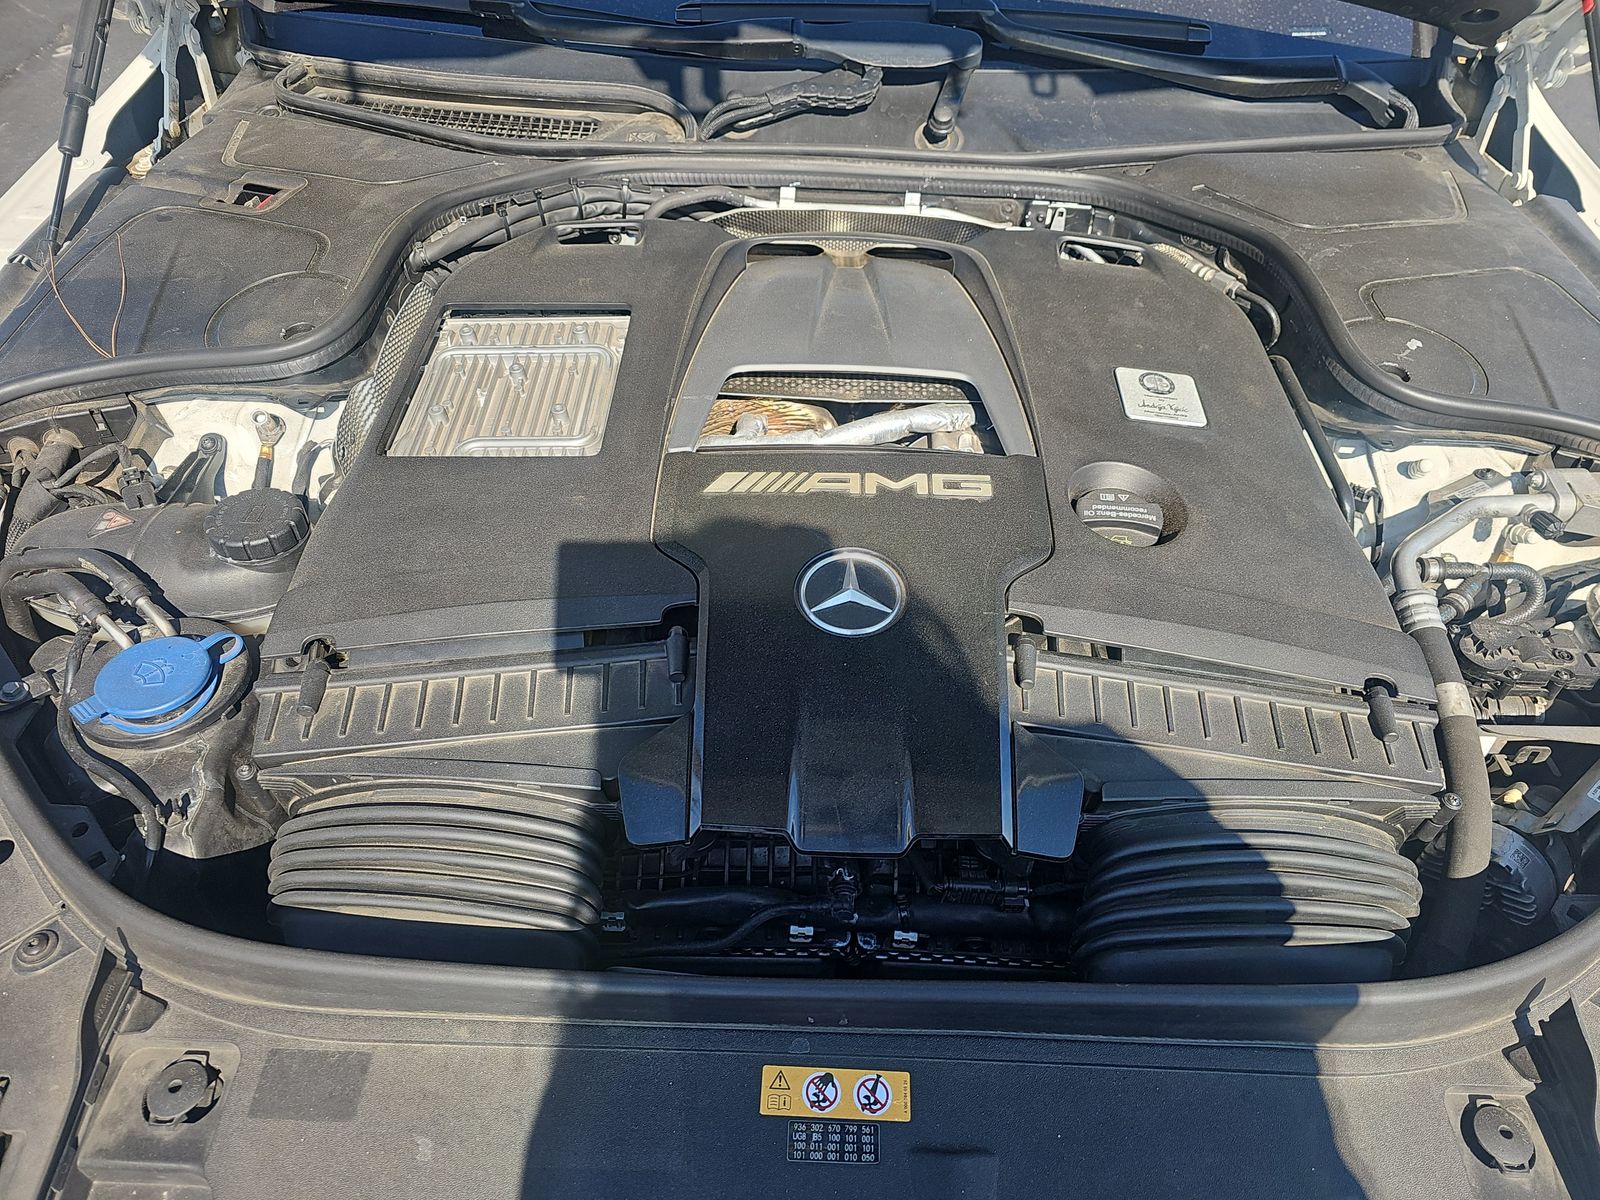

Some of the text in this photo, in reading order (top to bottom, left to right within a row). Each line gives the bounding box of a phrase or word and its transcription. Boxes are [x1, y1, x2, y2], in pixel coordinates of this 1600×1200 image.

[794, 472, 993, 497] AMG
[1091, 504, 1148, 514] recommended
[1096, 510, 1157, 521] Mercedes-Benz
[793, 1122, 806, 1131] 936
[810, 1124, 824, 1132] 302
[845, 1125, 858, 1133] 799
[862, 1126, 874, 1134] 561
[828, 1134, 841, 1142] 100
[846, 1134, 857, 1143] 101
[862, 1135, 874, 1144] 001
[794, 1142, 874, 1152] 100 011 001 001 101
[793, 1151, 875, 1162] 101 000 001 010 050
